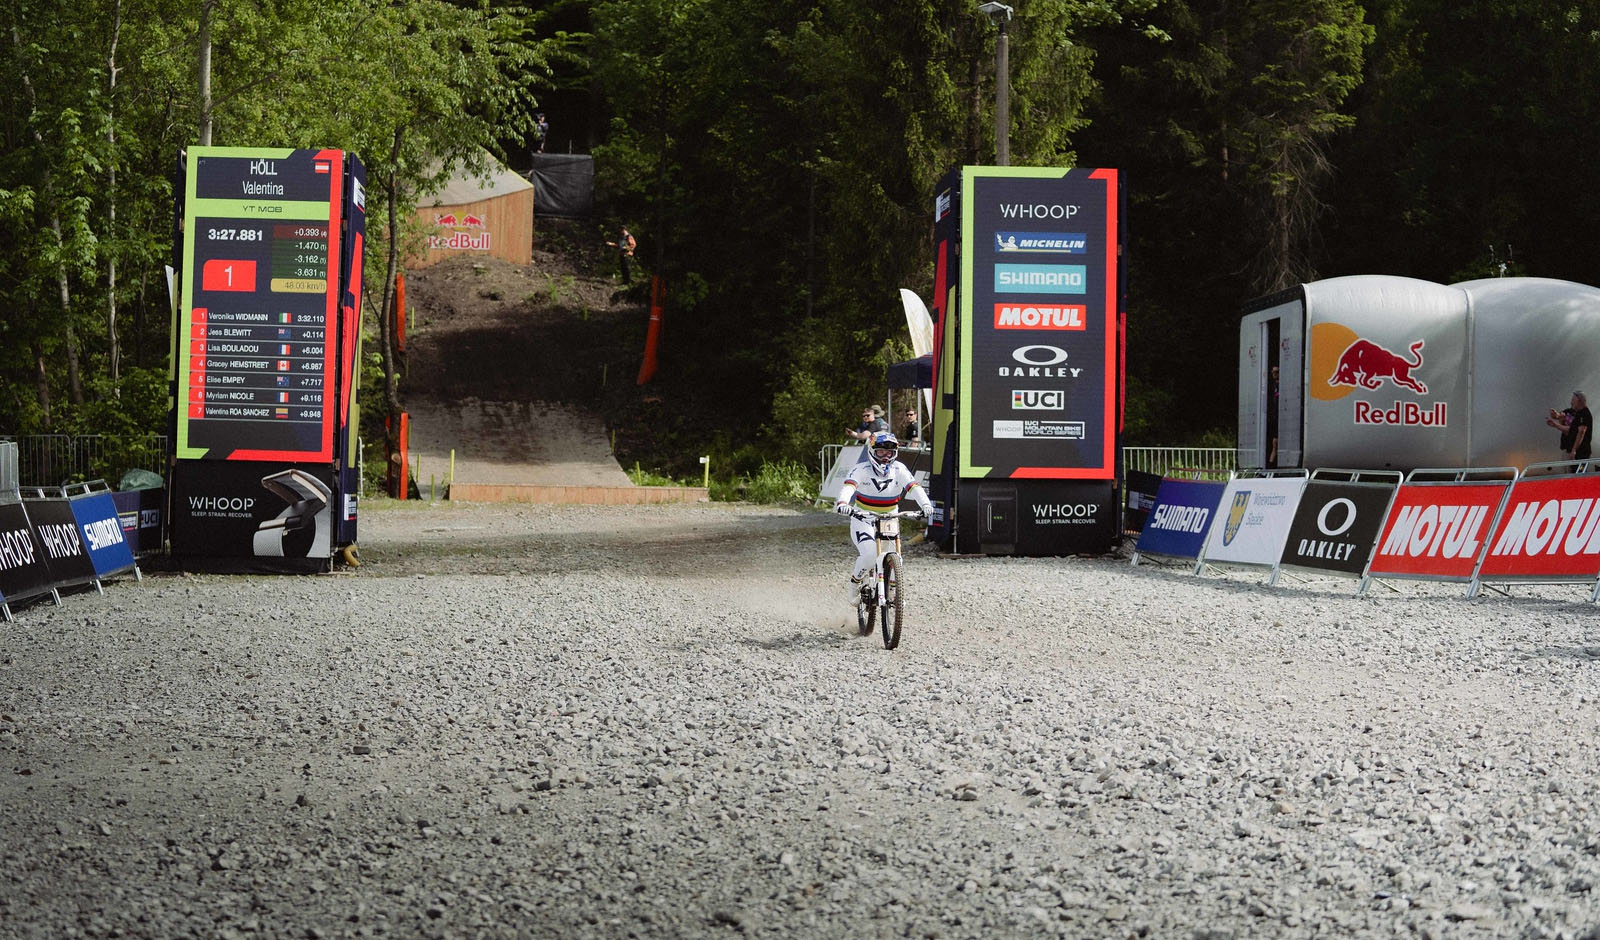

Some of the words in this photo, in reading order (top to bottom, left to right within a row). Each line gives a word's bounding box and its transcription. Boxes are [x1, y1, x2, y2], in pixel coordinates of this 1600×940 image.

[250, 159, 278, 176] HÖLL
[242, 180, 284, 196] Valentina
[243, 205, 256, 213] YT
[1000, 203, 1078, 219] WHOOP
[208, 228, 263, 241] 3:27.881
[294, 228, 320, 237] +0.393
[295, 241, 319, 250] -1.470
[1020, 239, 1085, 249] MICHELIN
[294, 254, 319, 264] -3.162
[224, 265, 233, 287] 1
[294, 268, 317, 277] -3.631
[999, 271, 1081, 286] SHIMANO
[200, 312, 206, 320] 1
[208, 312, 235, 321] Veronika
[235, 313, 269, 322] WIDMANN
[297, 314, 325, 323] 3:32.110
[998, 307, 1082, 327] MOTUL
[199, 327, 206, 336] 2
[207, 328, 223, 336] Jess
[223, 328, 252, 337] BLEWITT
[302, 331, 324, 339] +0.114
[199, 343, 205, 352] 3
[207, 344, 221, 352] Lisa
[221, 344, 259, 353] BOULADOU
[206, 360, 229, 370] Gracey
[229, 360, 270, 369] HEMSTREET
[998, 367, 1082, 377] OAKLEY
[206, 375, 222, 384] Elise
[222, 376, 246, 384] EMPEY
[300, 378, 323, 386] +7.717
[206, 391, 229, 400] Myriam
[229, 392, 255, 400] NICOLE
[1023, 392, 1062, 408] UCI
[197, 407, 203, 415] 7
[205, 407, 229, 416] Valentina
[229, 408, 242, 416] ROA
[242, 408, 270, 417] SANCHEZ
[1354, 401, 1401, 425] Red
[1404, 402, 1447, 427] Bull
[188, 496, 256, 511] WHOOP
[1032, 504, 1099, 517] WHOOP
[1150, 504, 1209, 534] SHIMANO
[83, 517, 123, 551] SHIMANO
[1380, 504, 1489, 559] MOTUL
[38, 523, 82, 559] WHOOP
[1297, 539, 1355, 561] OAKLEY
